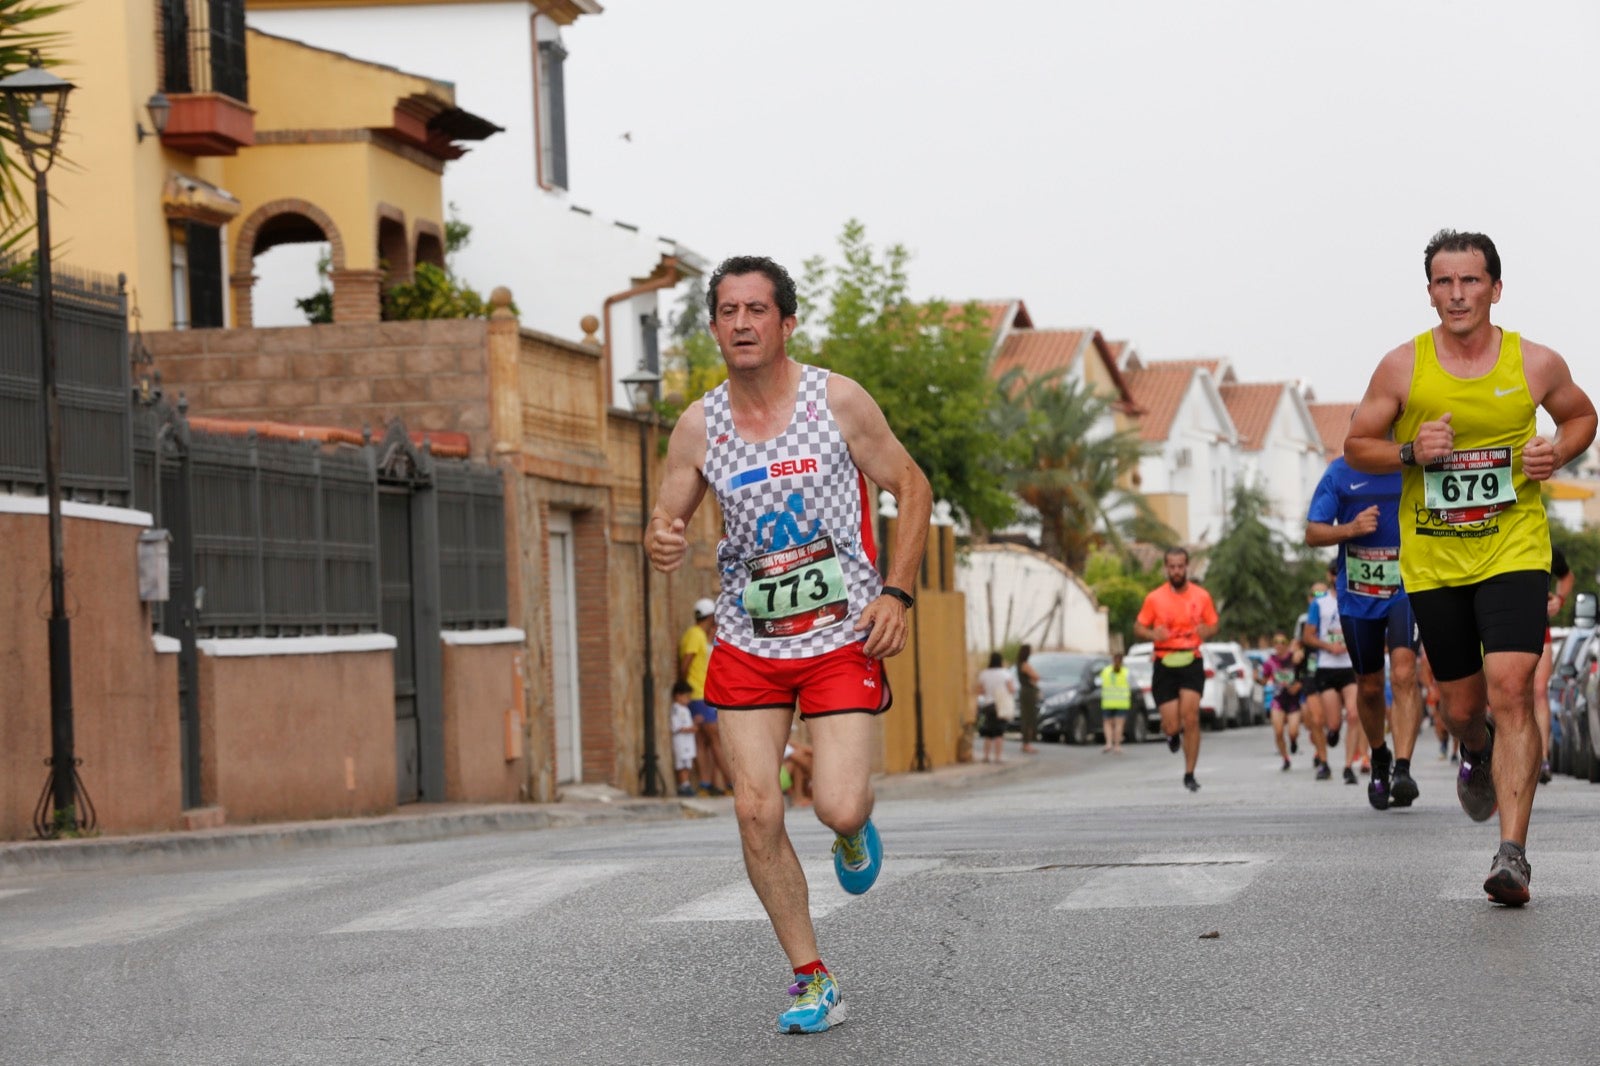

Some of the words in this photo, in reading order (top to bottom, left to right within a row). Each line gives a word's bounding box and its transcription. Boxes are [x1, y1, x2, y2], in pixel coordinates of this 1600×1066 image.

[1459, 451, 1480, 462] PREMIO
[1481, 450, 1489, 460] DE
[1489, 449, 1507, 460] FONDO
[770, 458, 818, 478] SEUR
[1441, 472, 1499, 503] 679
[773, 549, 799, 566] PREMIO
[798, 547, 808, 558] DE
[1361, 563, 1386, 581] 34
[759, 568, 829, 612] 773
